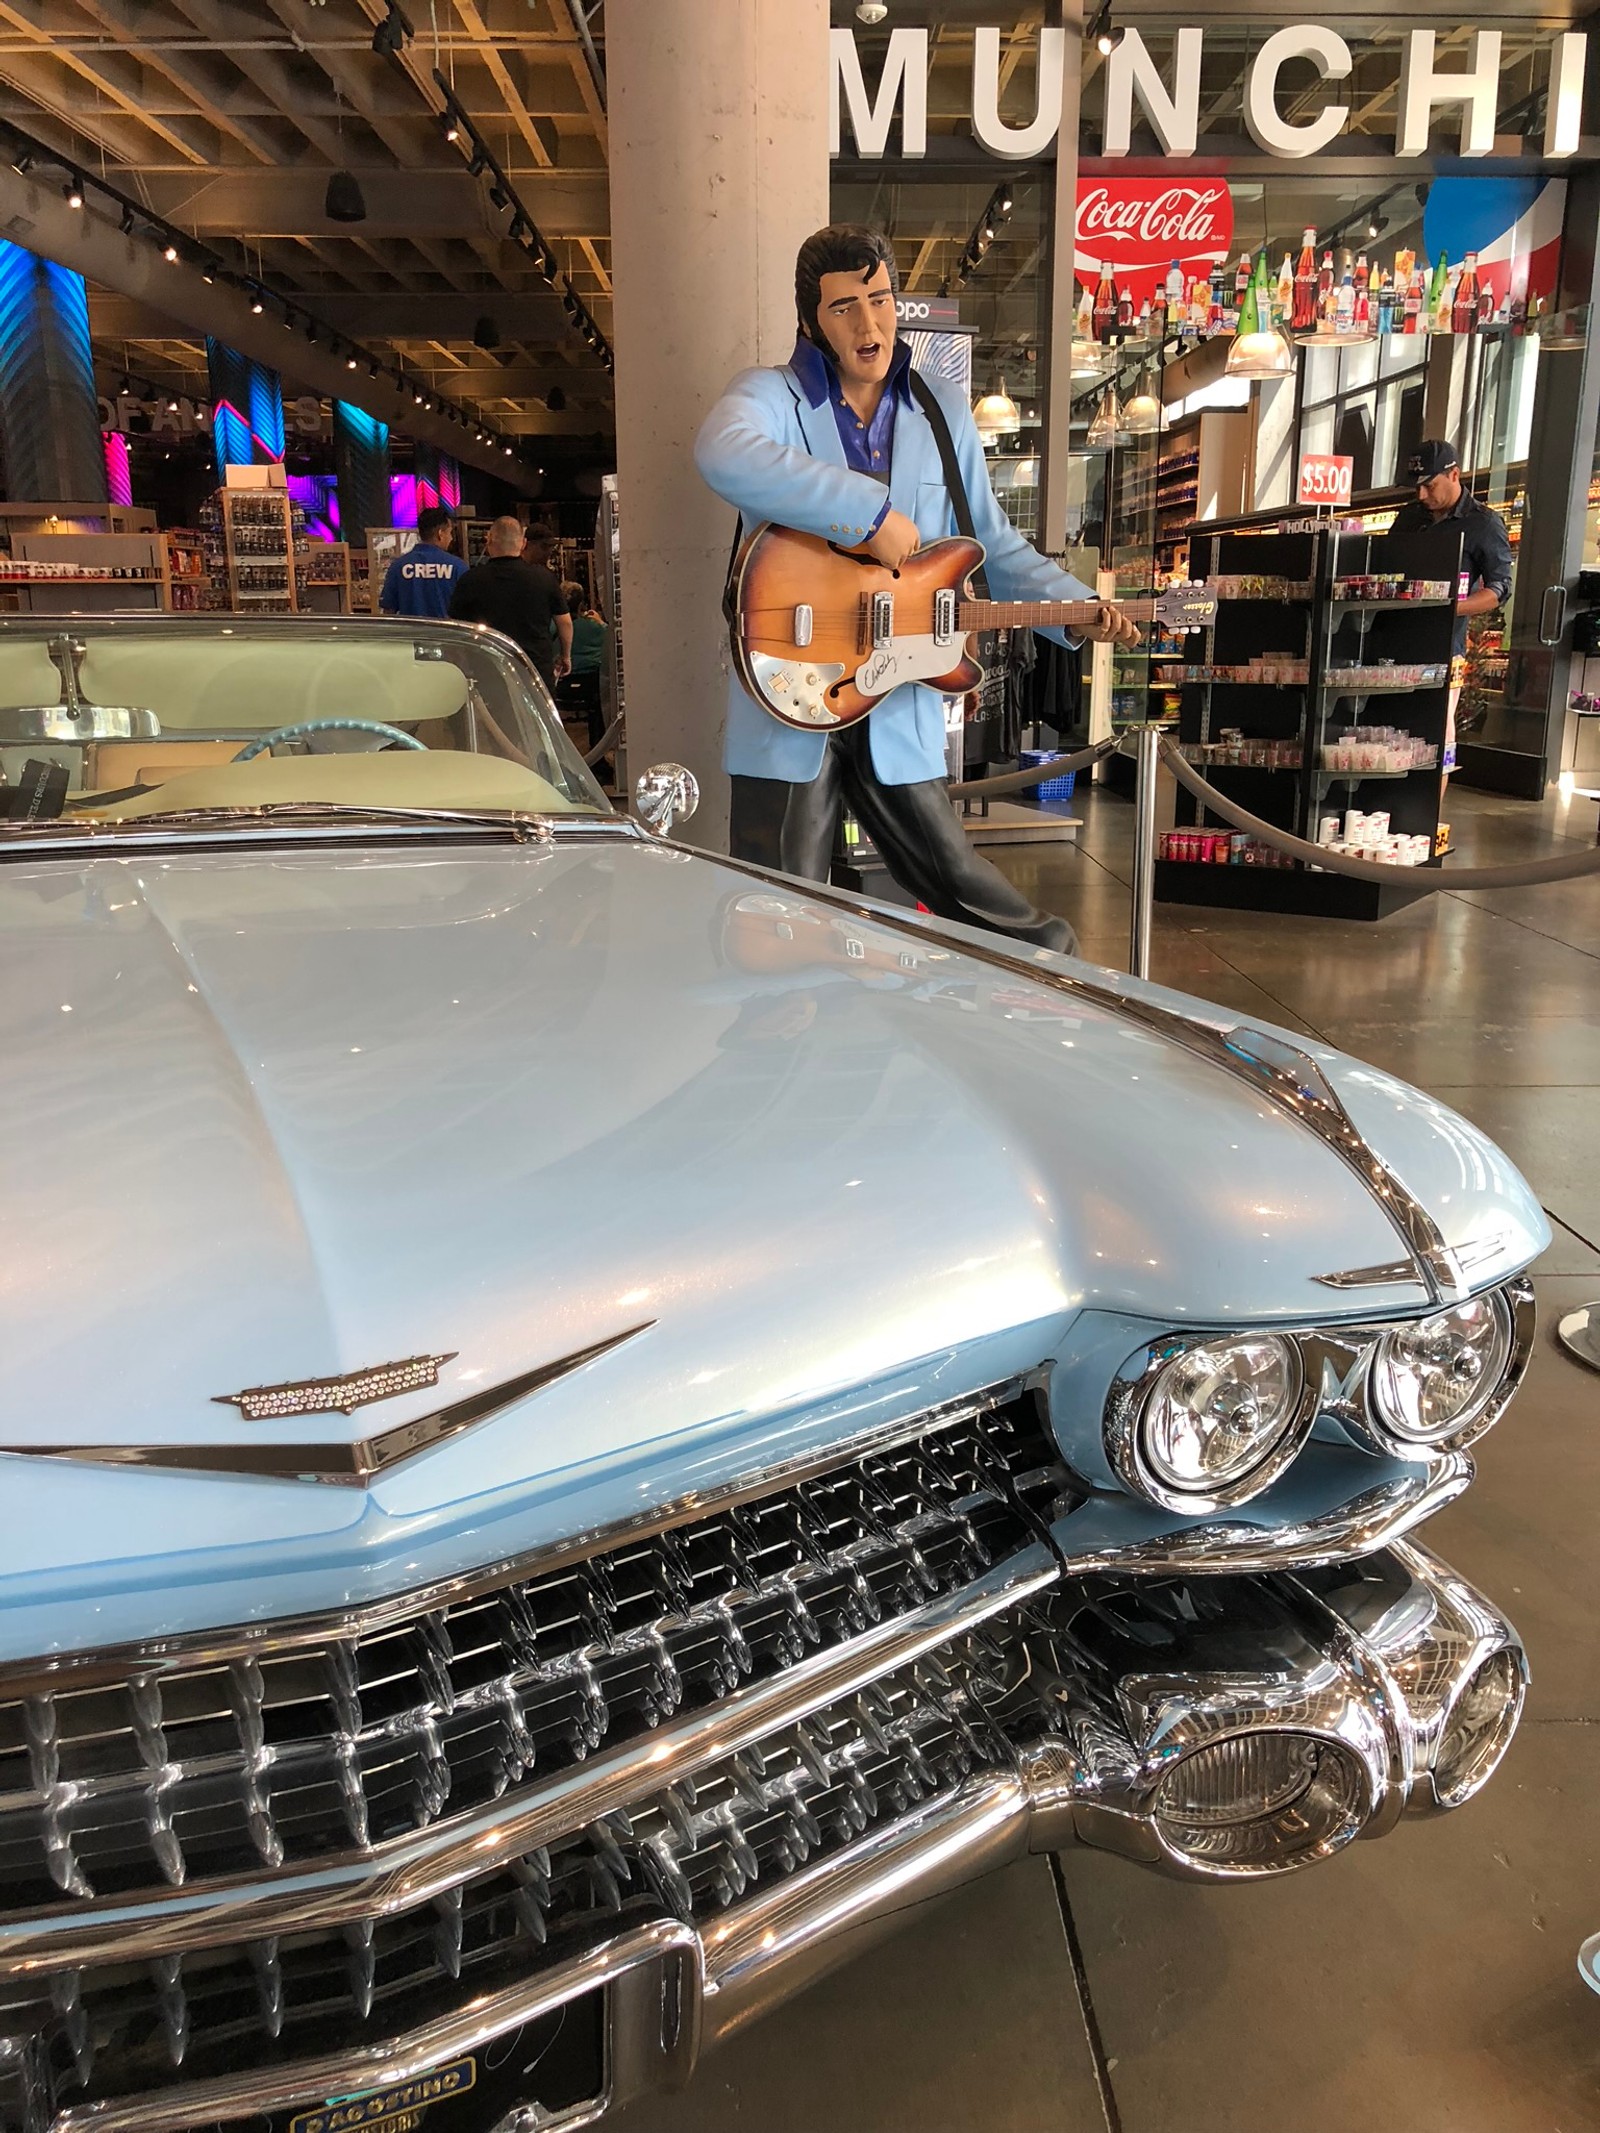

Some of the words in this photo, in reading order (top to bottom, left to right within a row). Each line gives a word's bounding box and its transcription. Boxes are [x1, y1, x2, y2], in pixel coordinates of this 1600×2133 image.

[830, 25, 1587, 159] MUNCHI
[1075, 188, 1226, 242] Coca-Cola
[1302, 462, 1350, 495] $5.00
[402, 563, 453, 579] CREW
